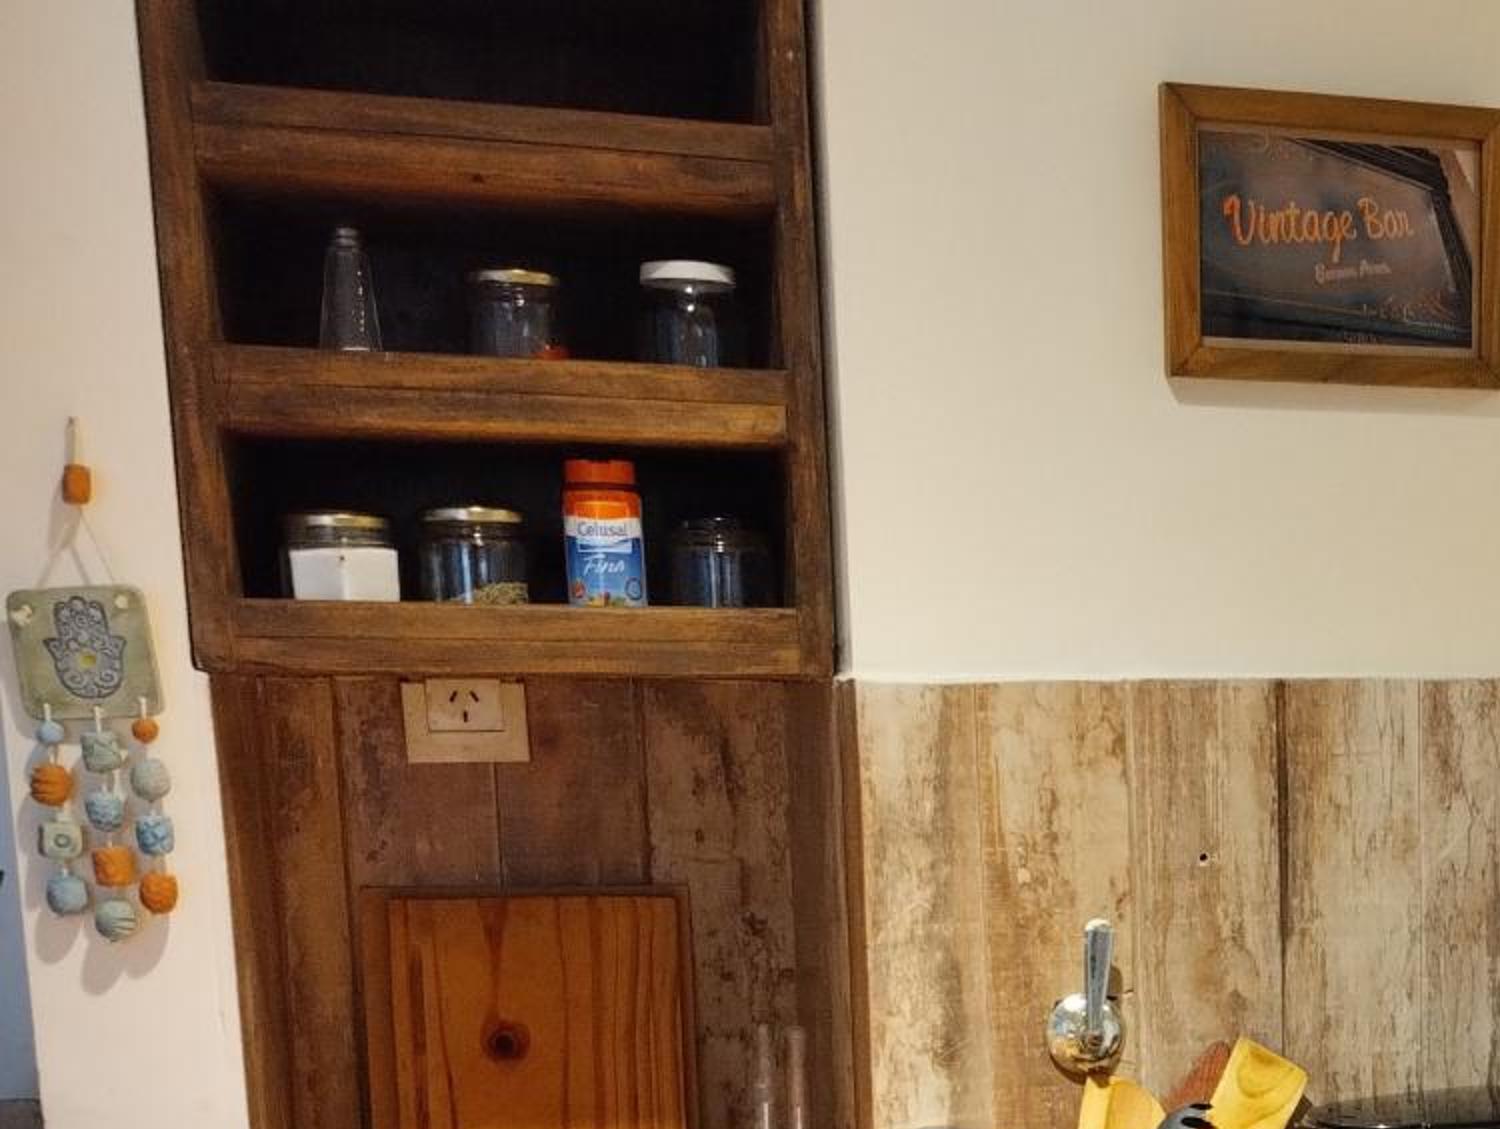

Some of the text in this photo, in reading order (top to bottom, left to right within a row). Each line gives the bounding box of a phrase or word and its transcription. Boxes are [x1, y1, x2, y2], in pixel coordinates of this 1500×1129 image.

[1223, 194, 1415, 263] Vintage Bar
[577, 521, 628, 537] Celusal
